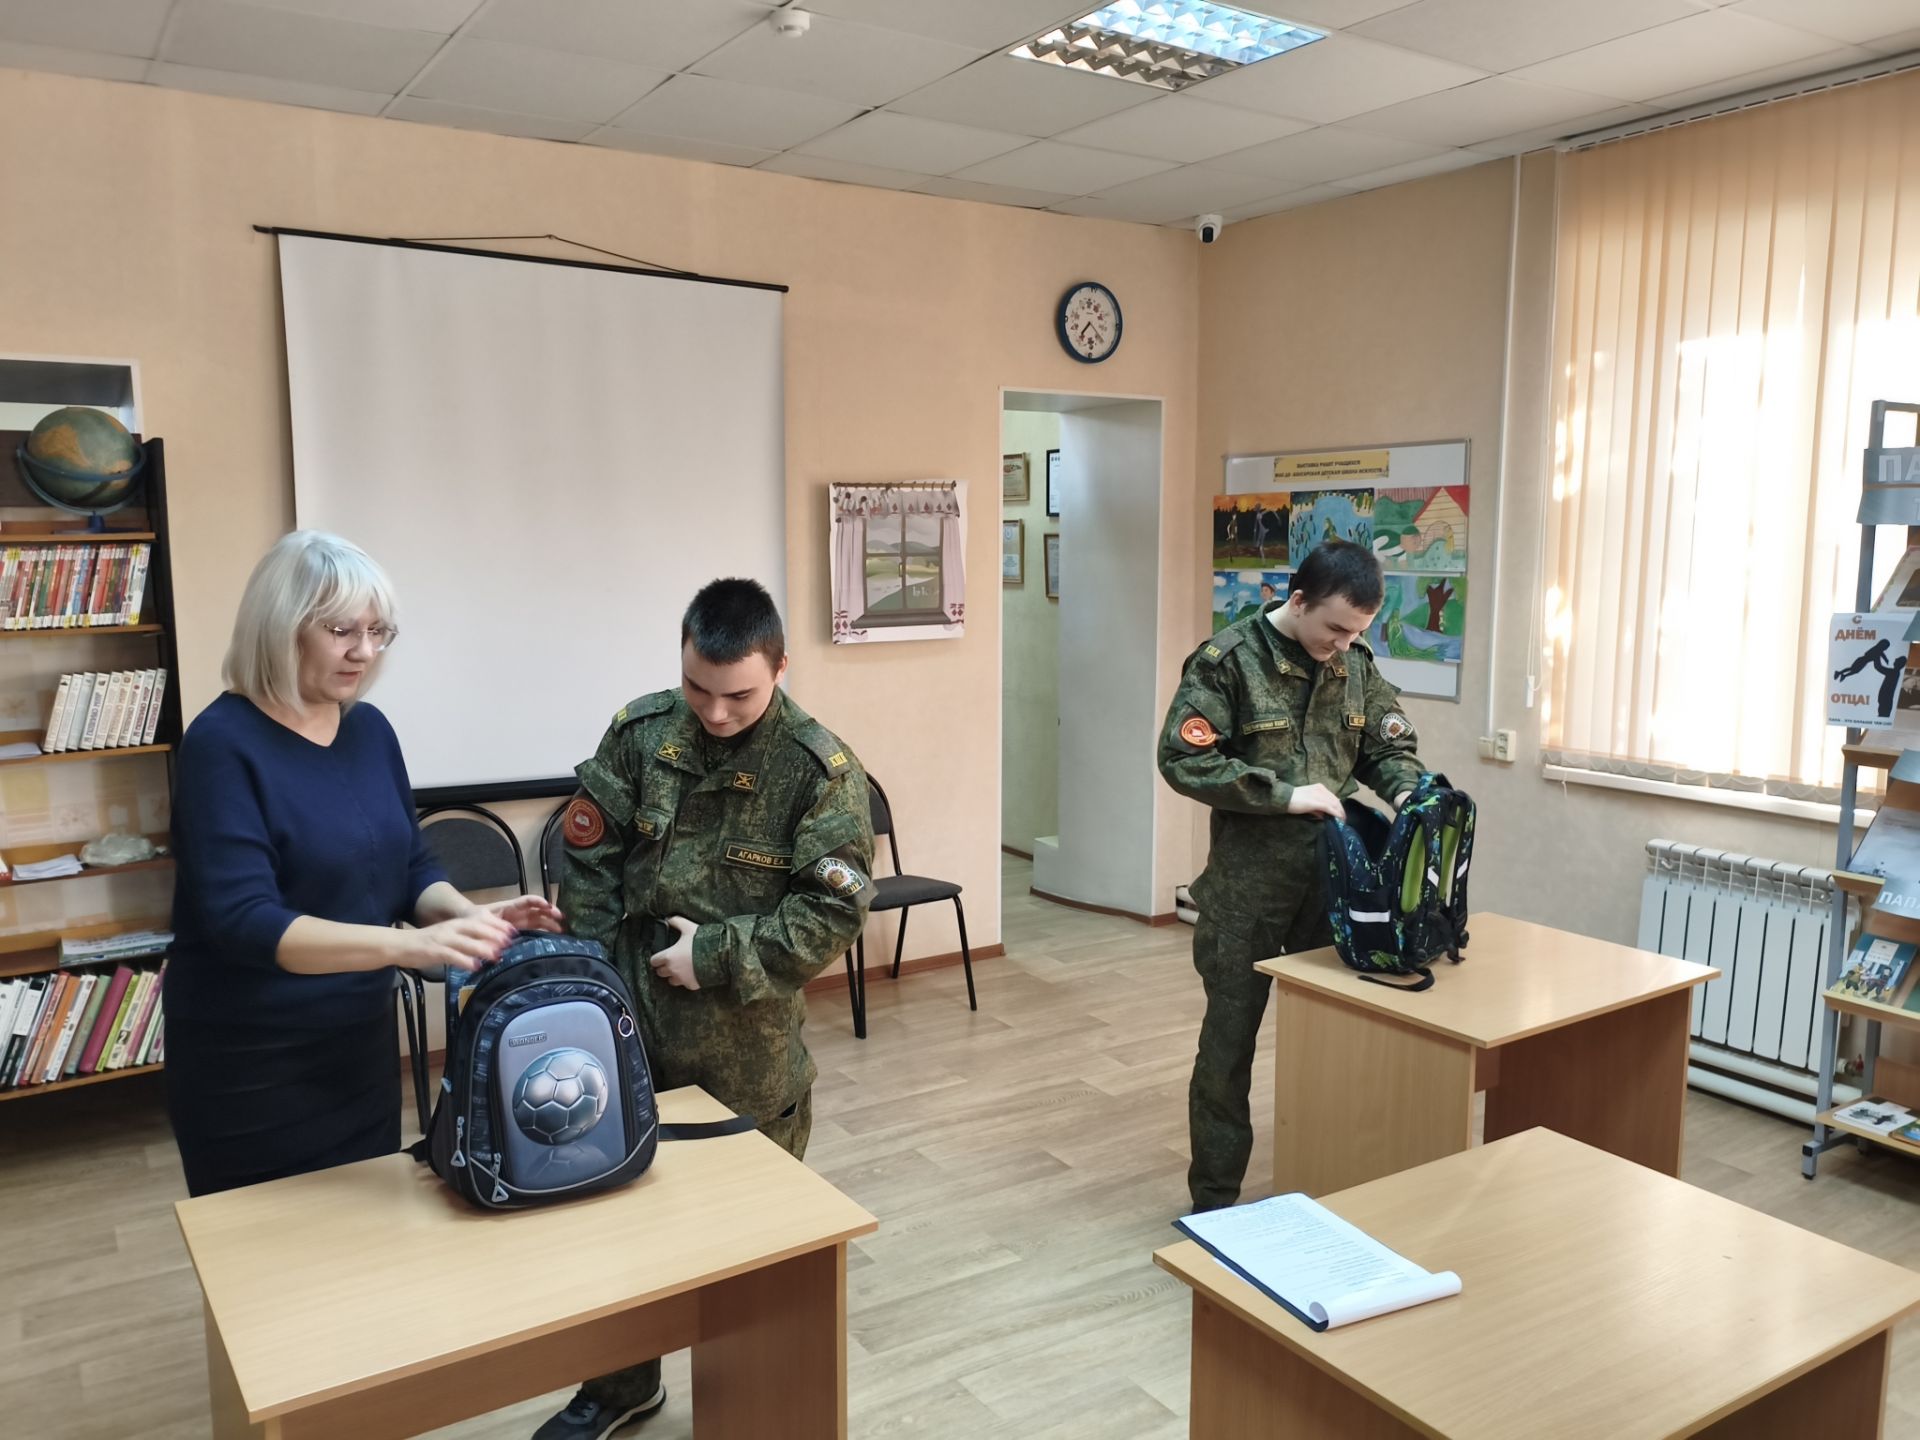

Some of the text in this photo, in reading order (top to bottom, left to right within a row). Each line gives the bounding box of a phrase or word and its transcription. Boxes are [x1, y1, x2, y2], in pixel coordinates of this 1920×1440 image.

[1835, 626, 1876, 642] ДНЁМ
[1831, 693, 1870, 706] ОТЦА!
[738, 850, 772, 865] АГАРКОВ
[1878, 890, 1920, 910] ПАП
[118, 1031, 126, 1045] 2
